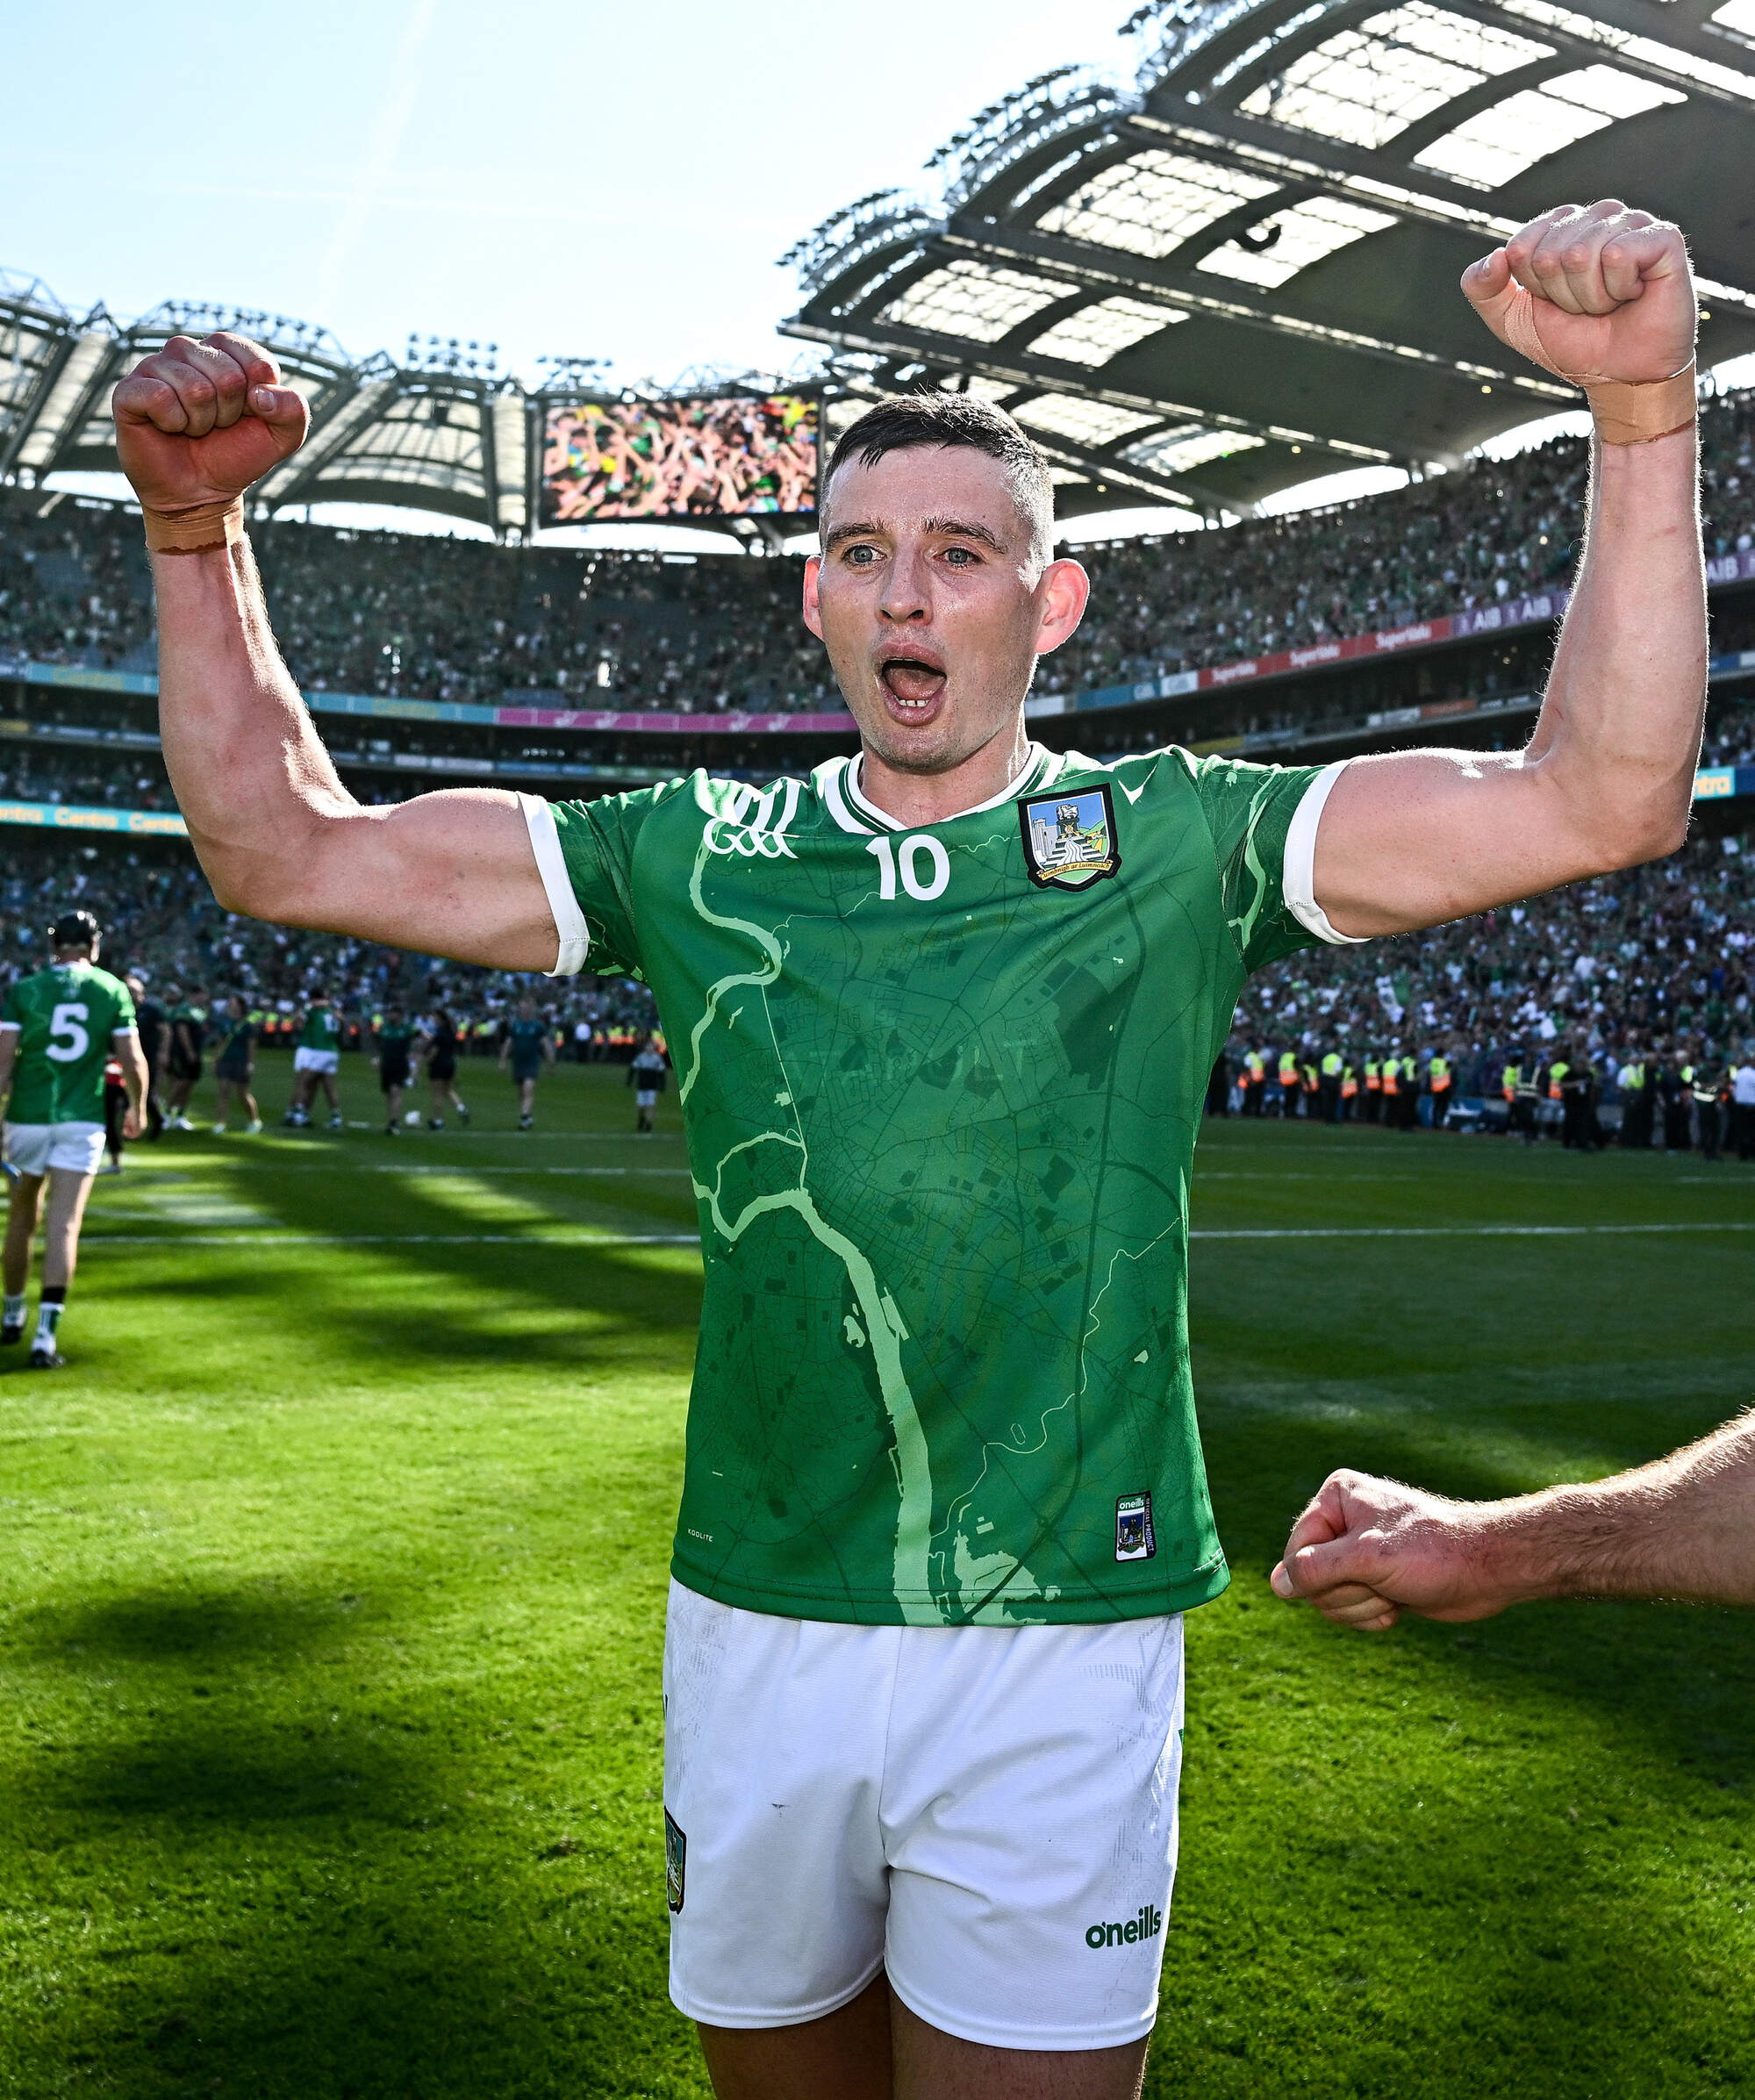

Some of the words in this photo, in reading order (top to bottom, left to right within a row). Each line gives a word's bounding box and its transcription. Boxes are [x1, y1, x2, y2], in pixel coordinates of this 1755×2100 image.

[865, 834, 950, 901] 10
[46, 1002, 89, 1063] 5
[687, 1528, 713, 1543] KOOLITE
[1145, 1523, 1155, 1552] PRODUCT
